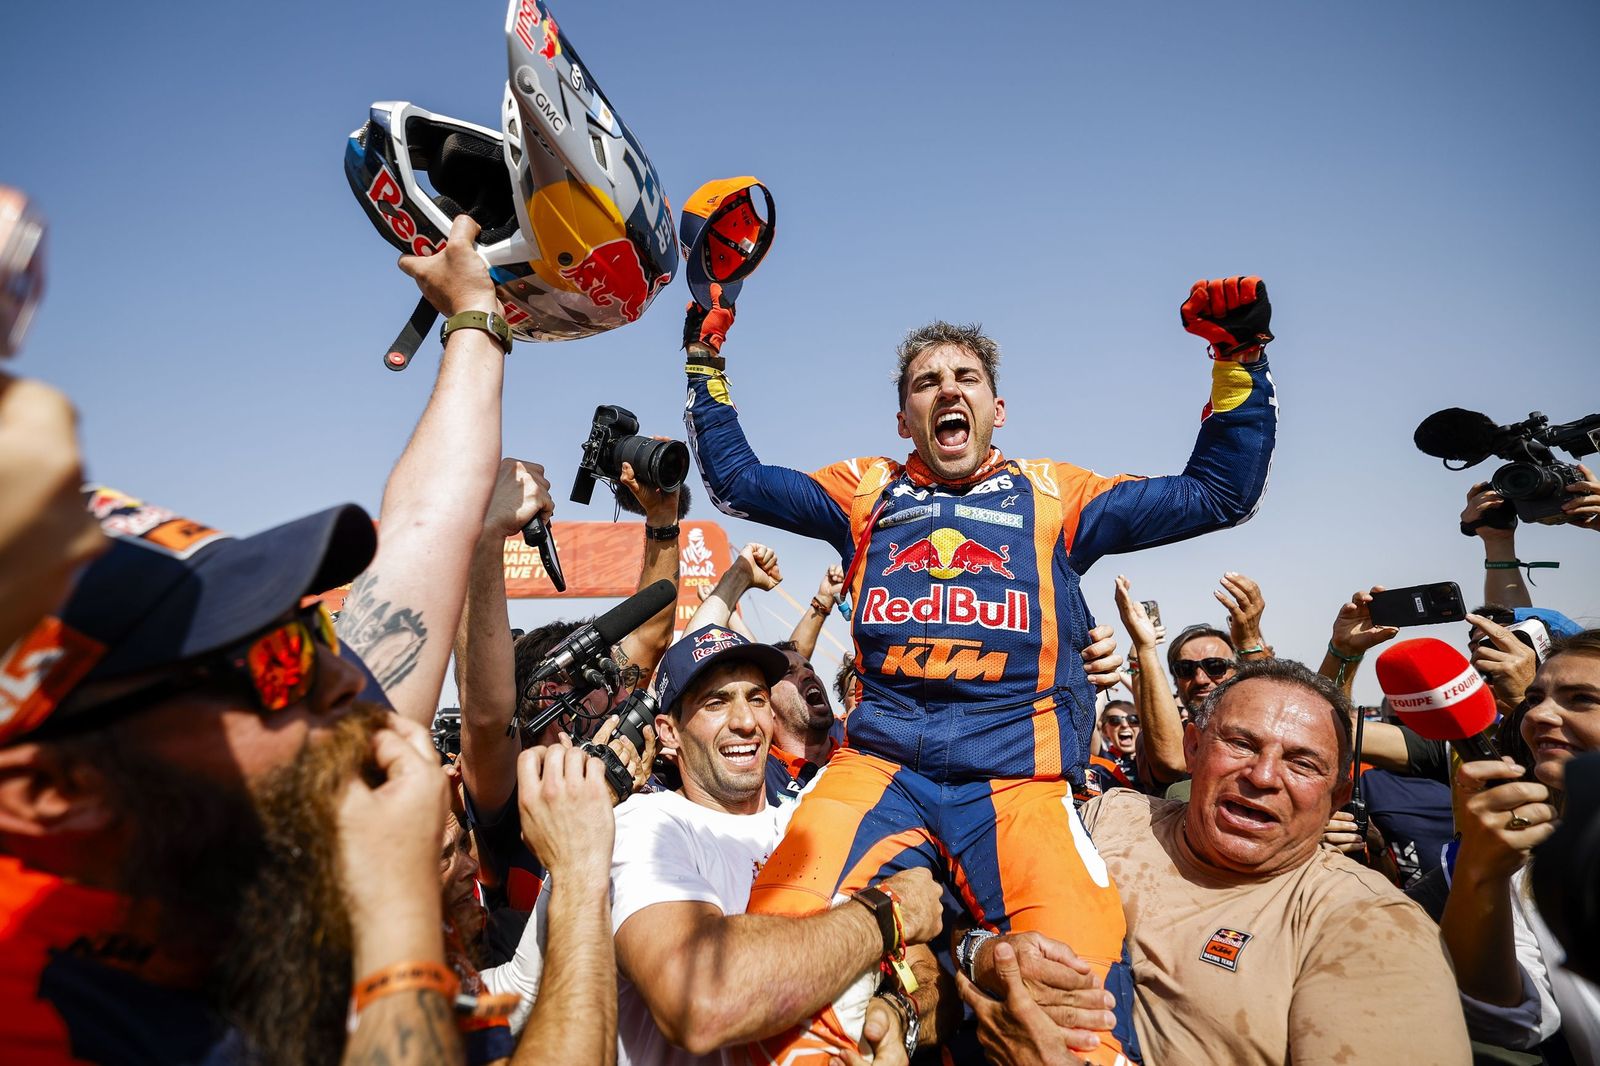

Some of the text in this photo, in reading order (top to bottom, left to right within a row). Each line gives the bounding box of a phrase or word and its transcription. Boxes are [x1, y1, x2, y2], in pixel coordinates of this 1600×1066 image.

[535, 93, 564, 132] GMC
[680, 560, 716, 577] DAKAR
[862, 584, 1029, 633] Red Bull
[880, 637, 1008, 681] KTM
[1444, 673, 1479, 700] L'EQUIPE
